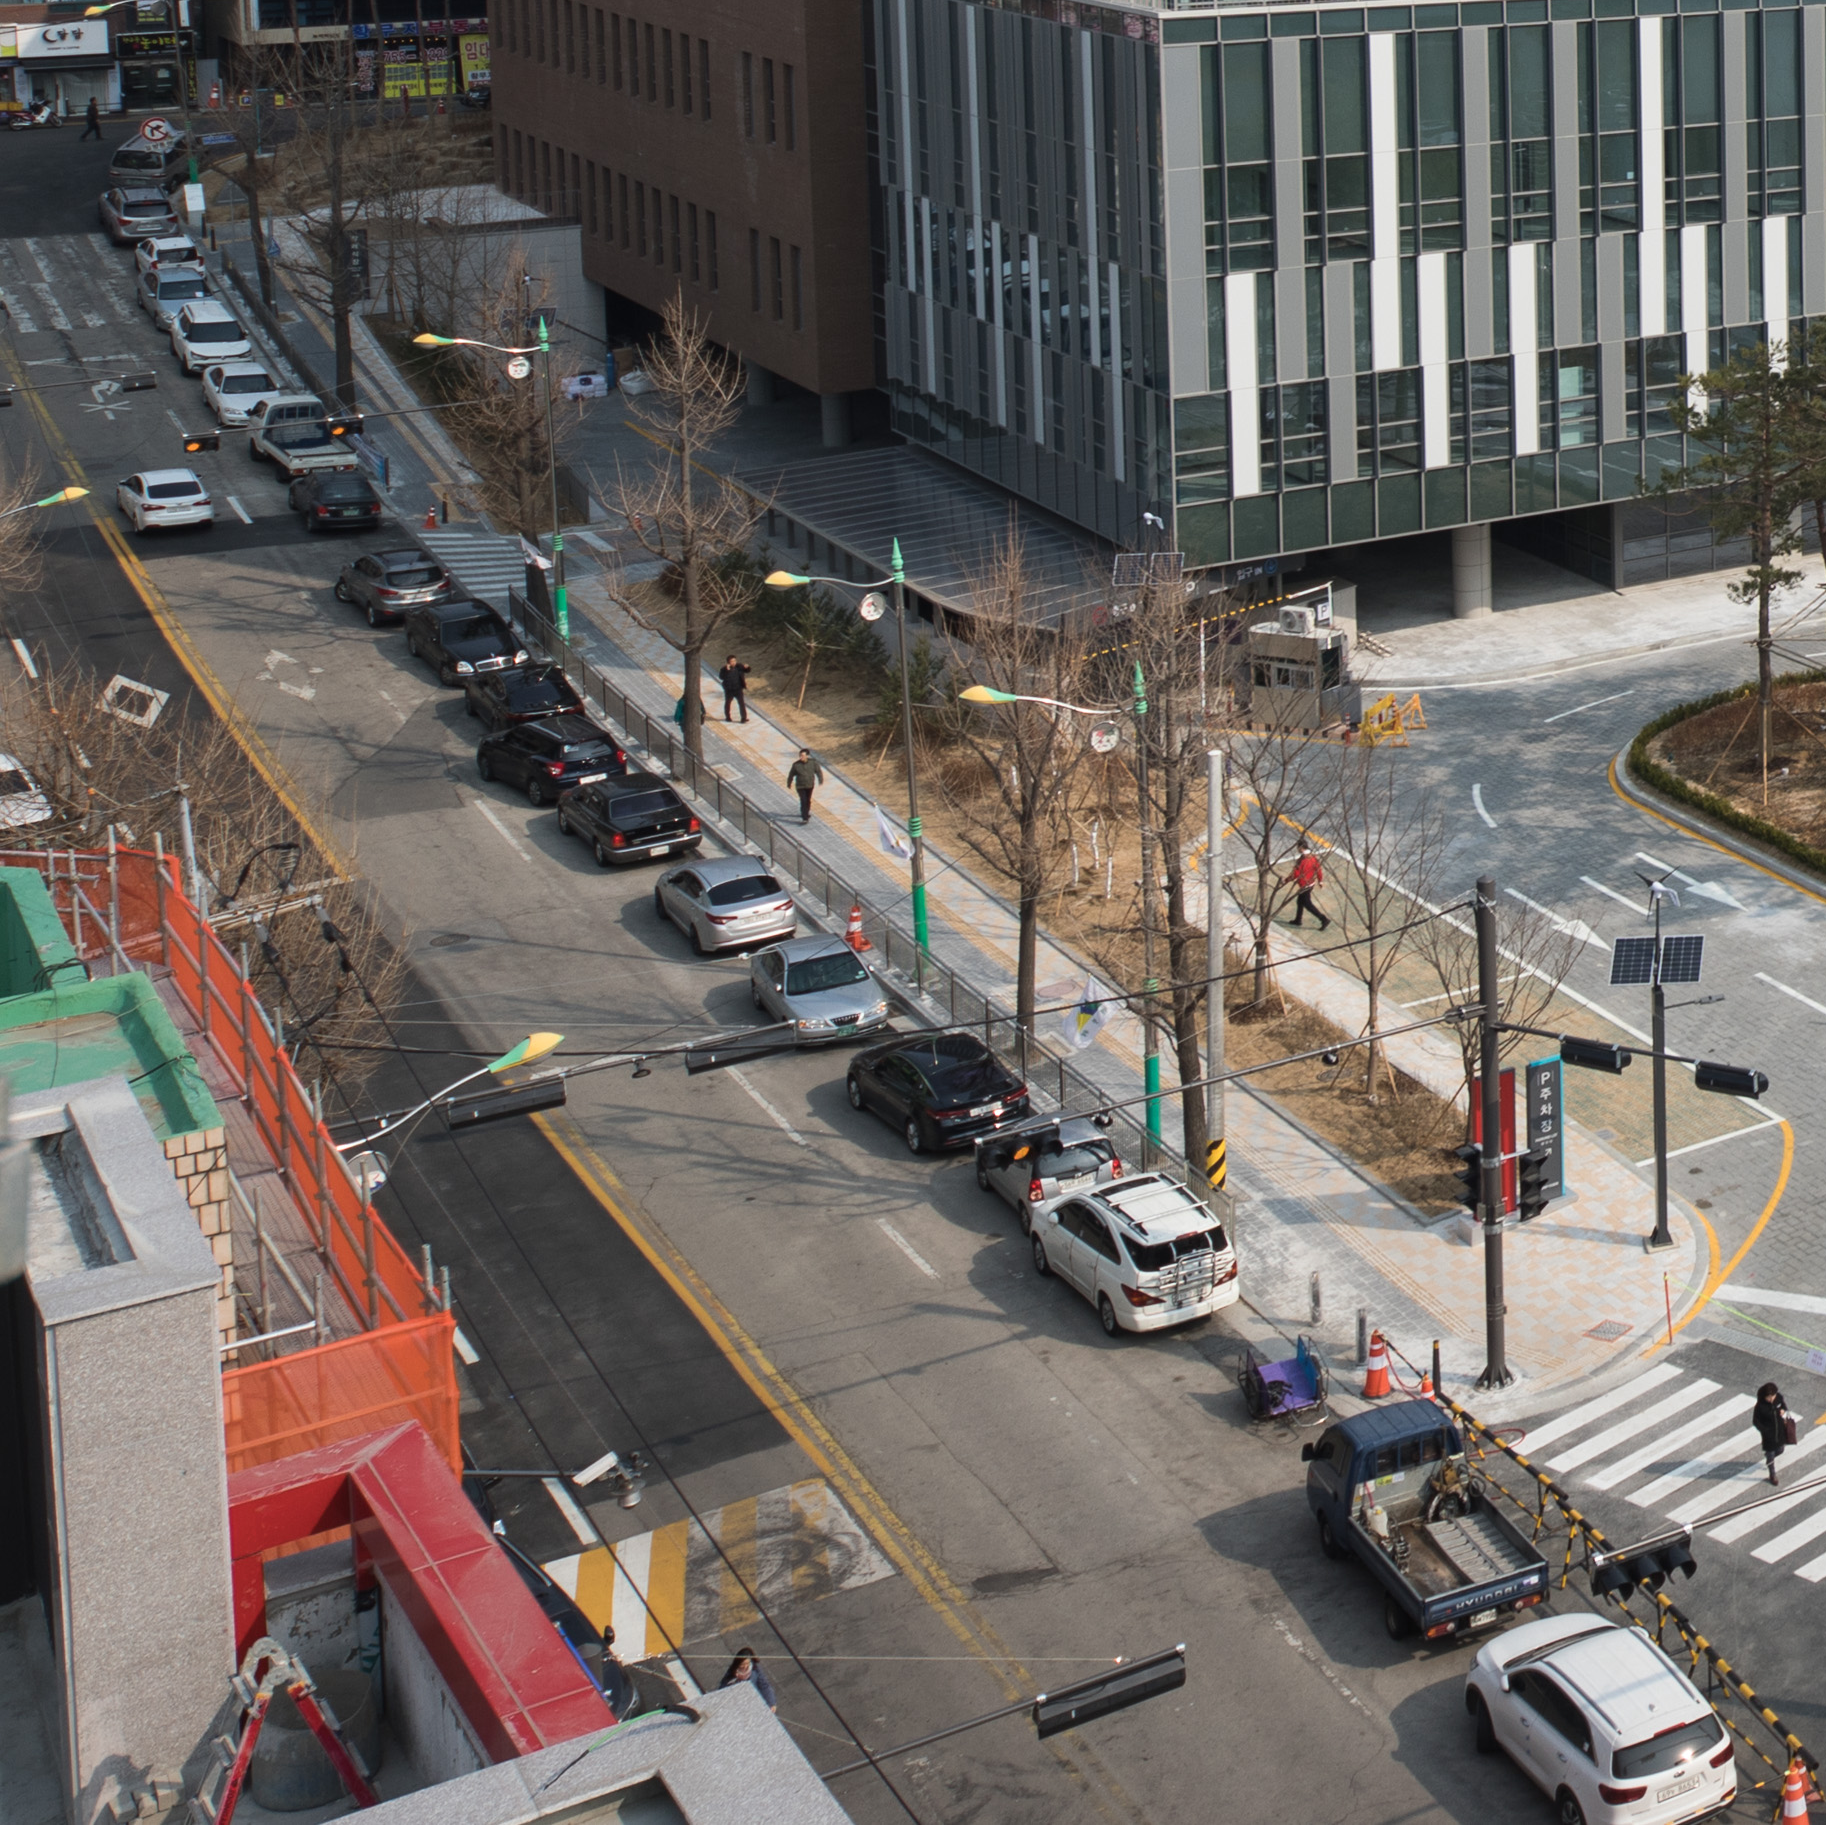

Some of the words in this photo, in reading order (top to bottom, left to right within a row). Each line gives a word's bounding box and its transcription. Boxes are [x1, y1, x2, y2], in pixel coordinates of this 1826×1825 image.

[1540, 1071, 1551, 1086] P
[1540, 1088, 1553, 1134] 주차장
[1456, 1585, 1518, 1611] HYUNDAI
